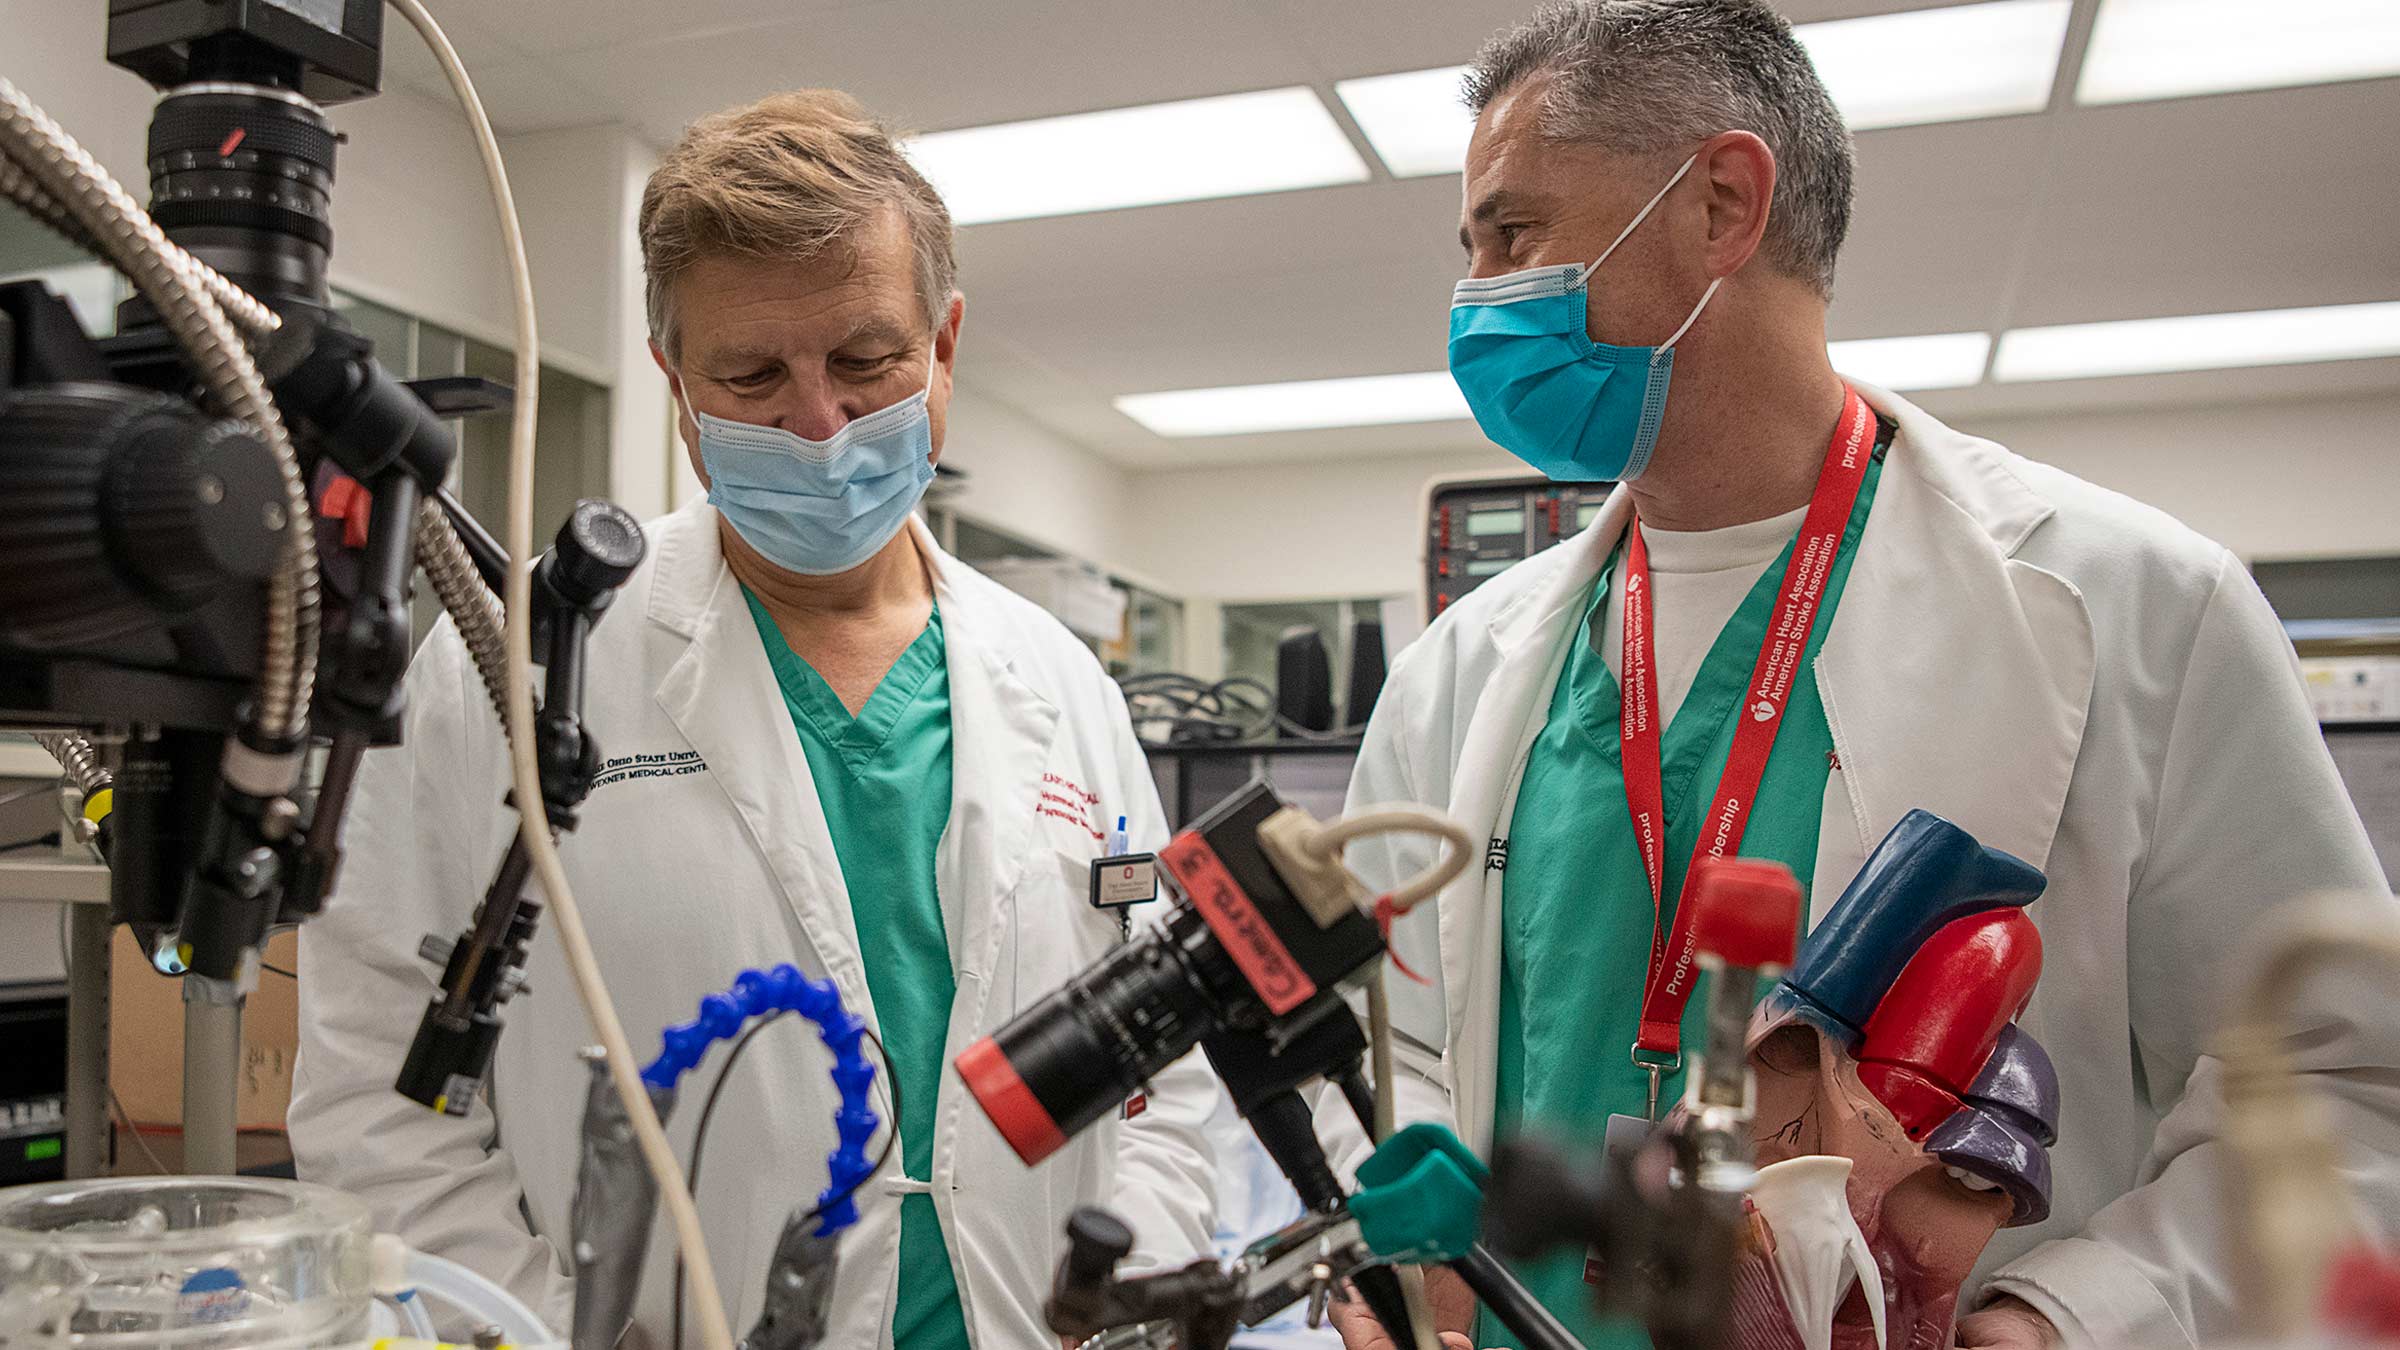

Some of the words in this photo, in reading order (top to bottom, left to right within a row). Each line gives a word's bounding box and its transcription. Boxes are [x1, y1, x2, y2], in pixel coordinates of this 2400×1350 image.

[1625, 595, 1634, 642] American
[1634, 589, 1643, 636] American
[1757, 640, 1785, 699] American
[1776, 603, 1797, 637] Heart
[1789, 536, 1821, 602] Association
[1770, 642, 1799, 701] American
[1790, 601, 1813, 640] Stroke
[1804, 533, 1836, 600] Association
[1625, 641, 1635, 675] Stroke
[1635, 636, 1645, 667] Heart
[1625, 677, 1636, 740] Association
[1635, 668, 1647, 732] Association
[590, 773, 625, 790] WEXNER
[629, 767, 674, 779] MEDICAL
[1709, 798, 1739, 862] bership
